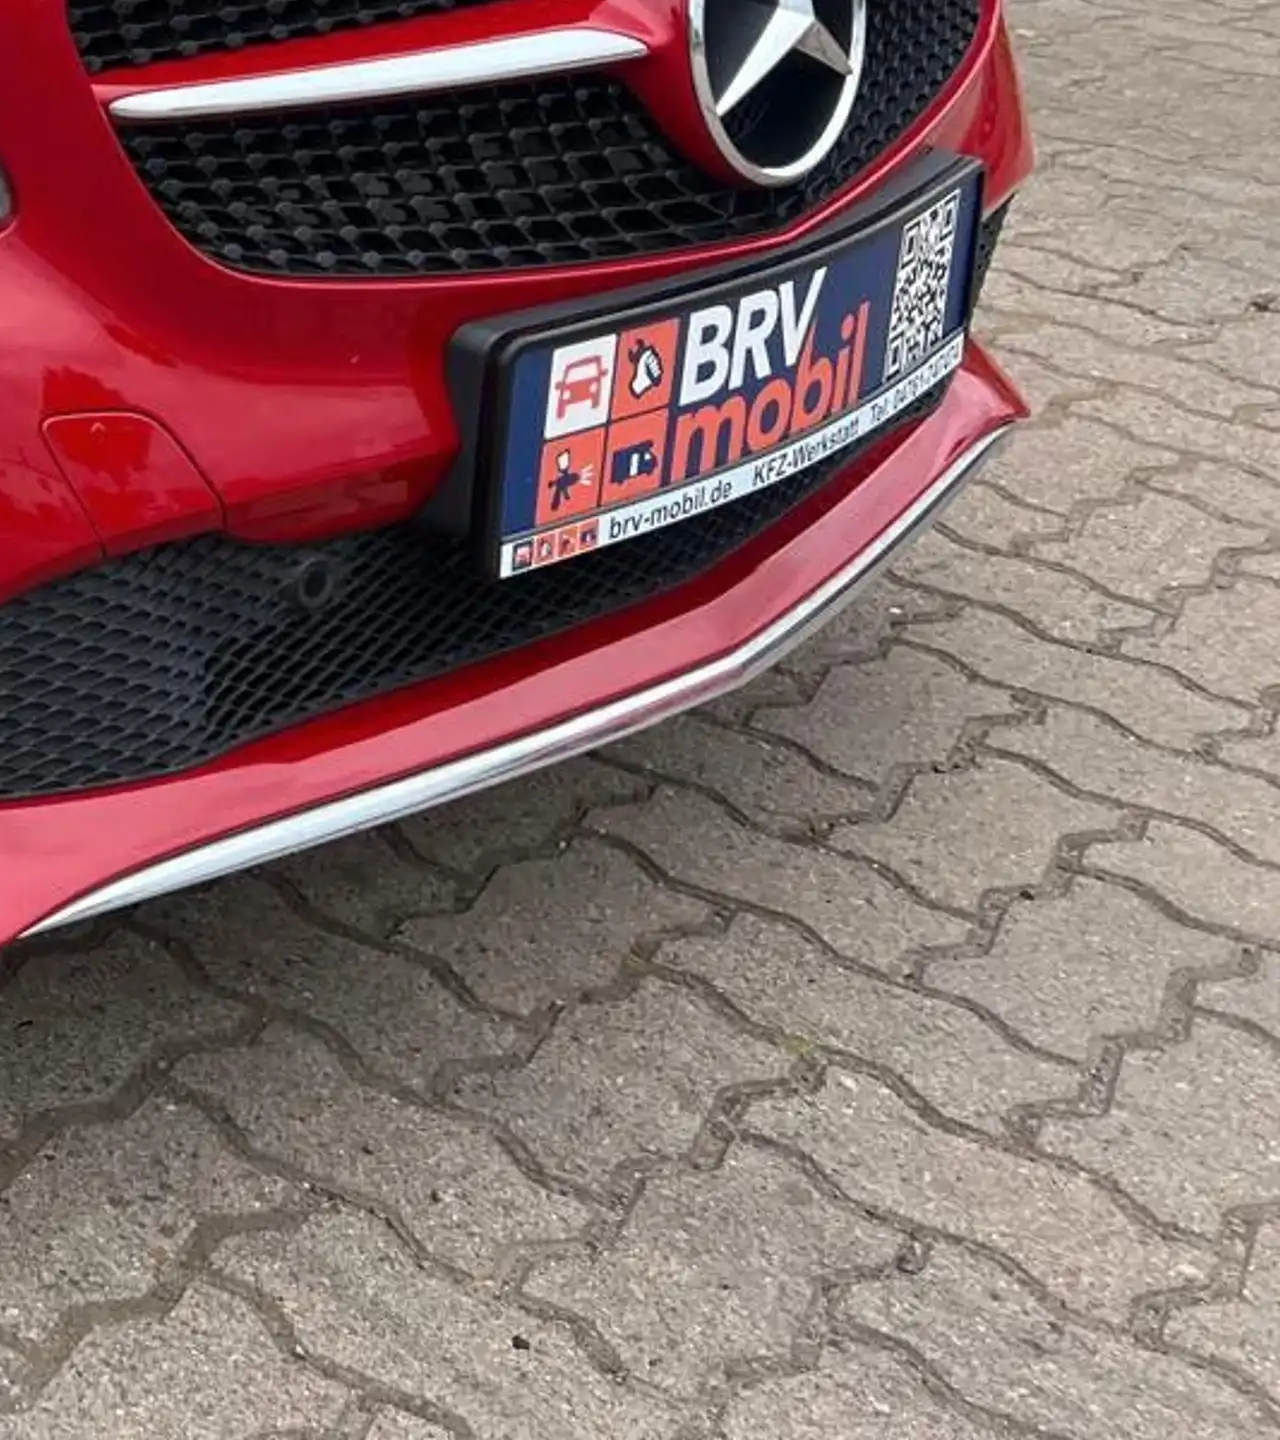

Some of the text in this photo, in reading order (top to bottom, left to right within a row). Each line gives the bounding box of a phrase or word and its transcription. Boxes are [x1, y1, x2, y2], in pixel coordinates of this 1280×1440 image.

[670, 300, 871, 482] mobil
[678, 266, 828, 406] BRV
[608, 481, 733, 540] brv-mobil.de
[751, 416, 859, 486] KFZ-Werkstatt
